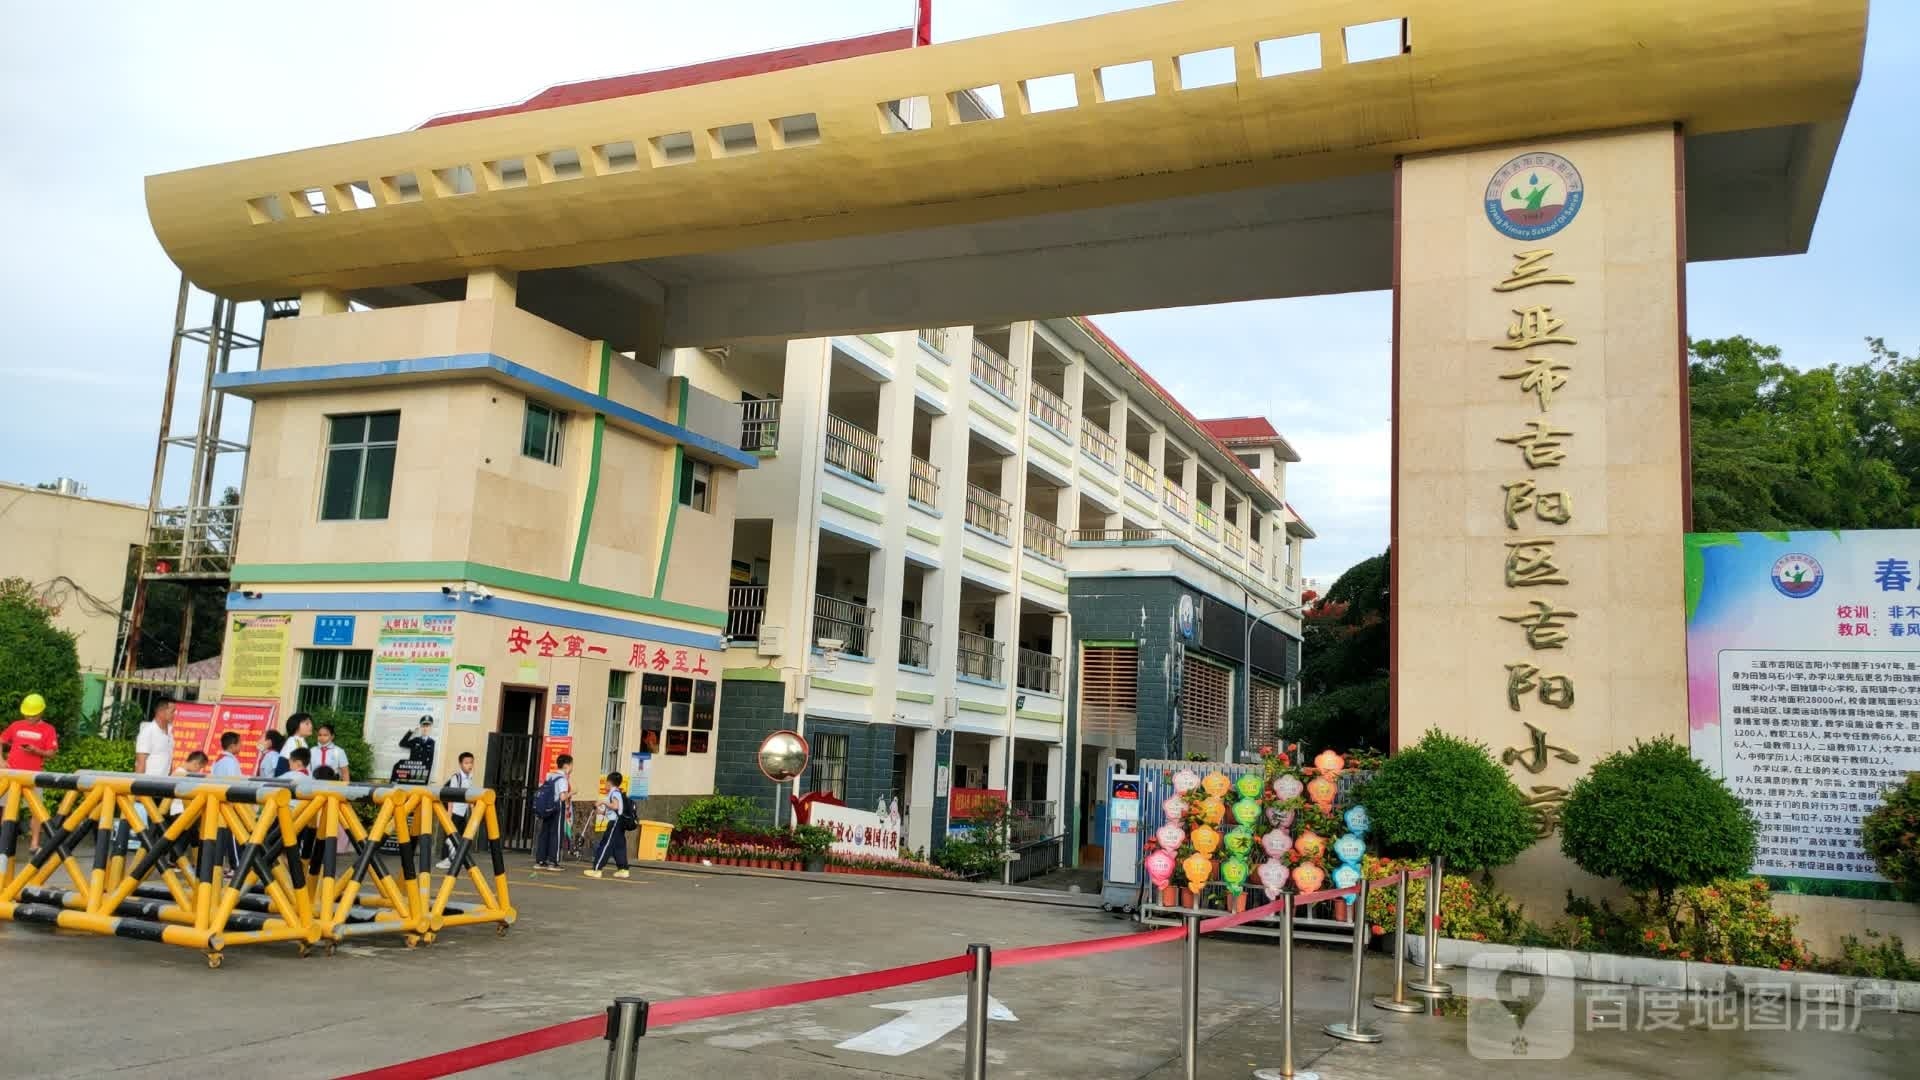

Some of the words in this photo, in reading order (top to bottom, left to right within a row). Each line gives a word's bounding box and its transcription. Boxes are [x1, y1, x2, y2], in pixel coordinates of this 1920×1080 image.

[1874, 558, 1920, 592] 春
[507, 625, 608, 658] 安全第一
[628, 643, 709, 676] 服务至上
[864, 827, 897, 850] 强国有我
